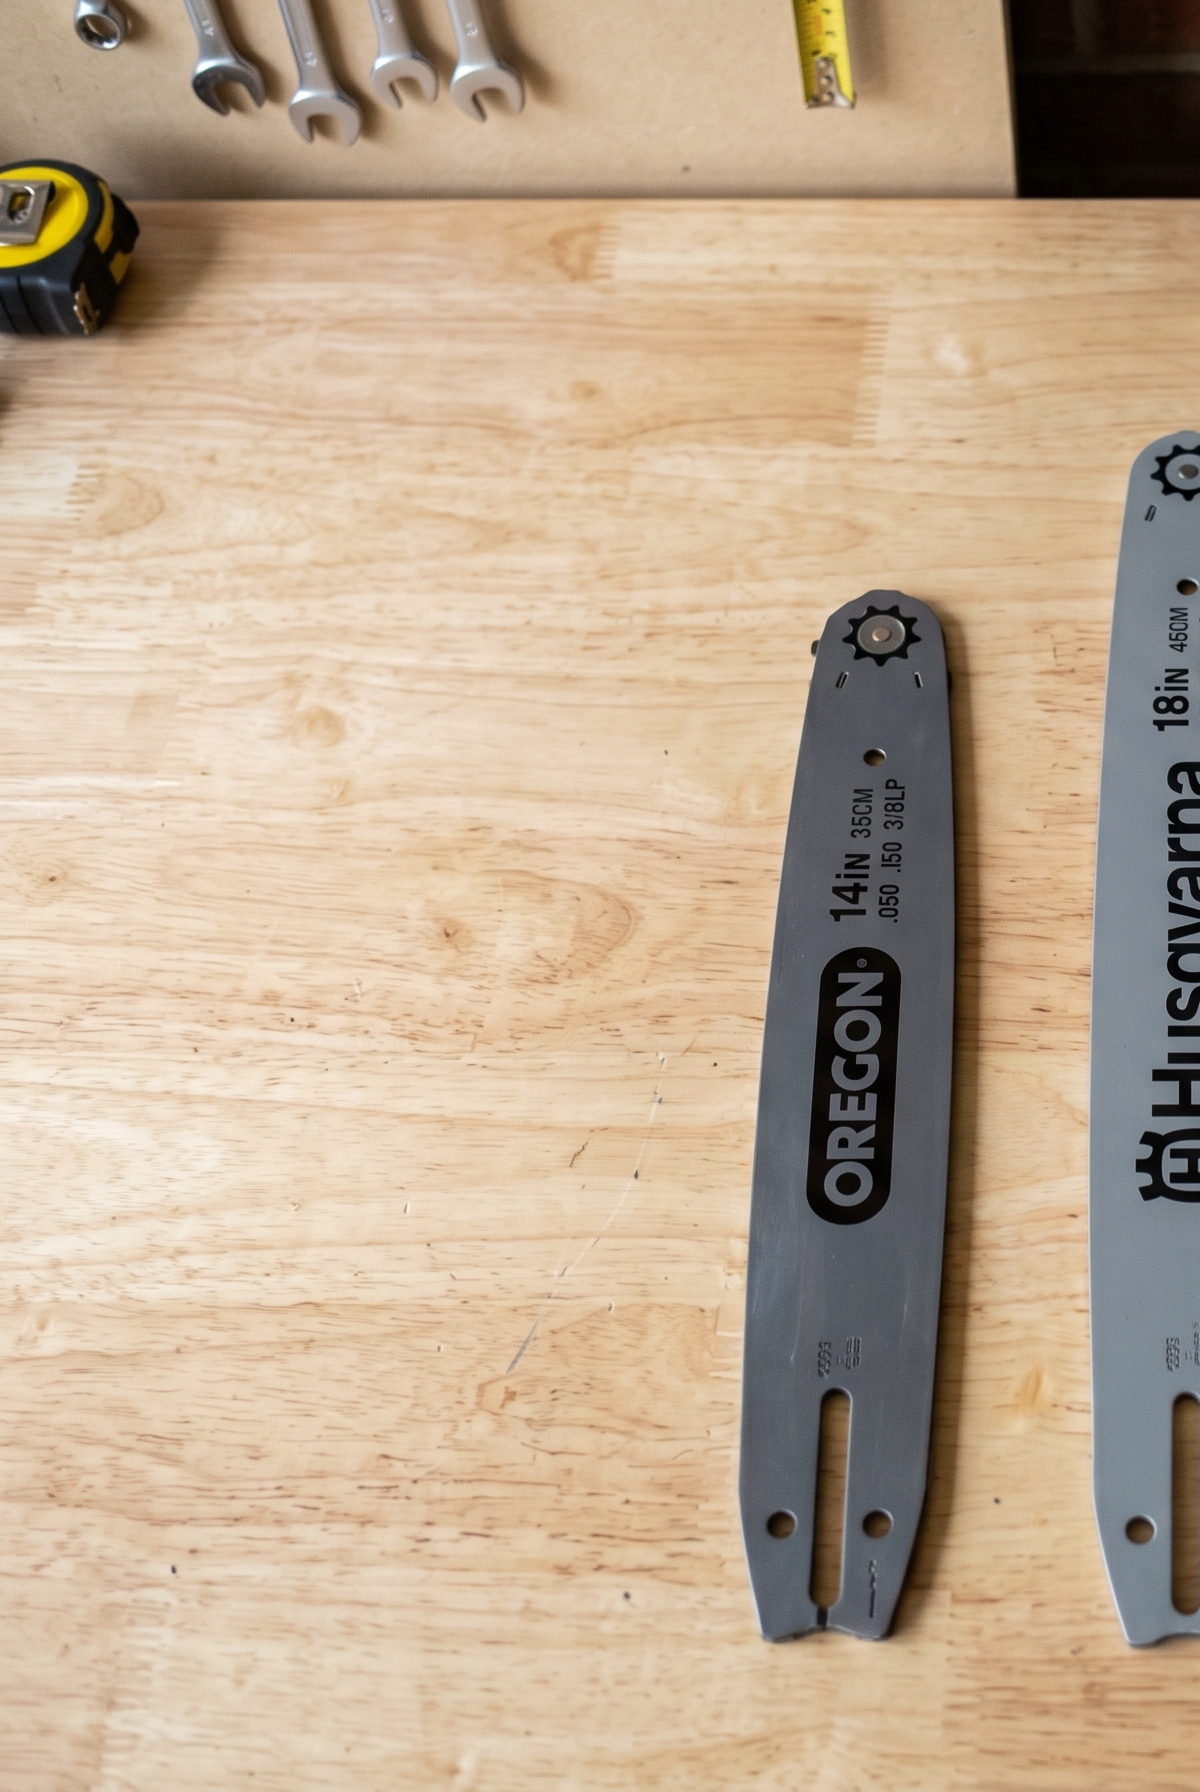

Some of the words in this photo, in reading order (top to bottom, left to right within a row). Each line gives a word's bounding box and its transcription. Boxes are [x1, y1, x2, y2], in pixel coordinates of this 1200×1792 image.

[850, 788, 874, 839] 35CM
[883, 778, 906, 831] 3/8LP
[878, 884, 900, 924] .050
